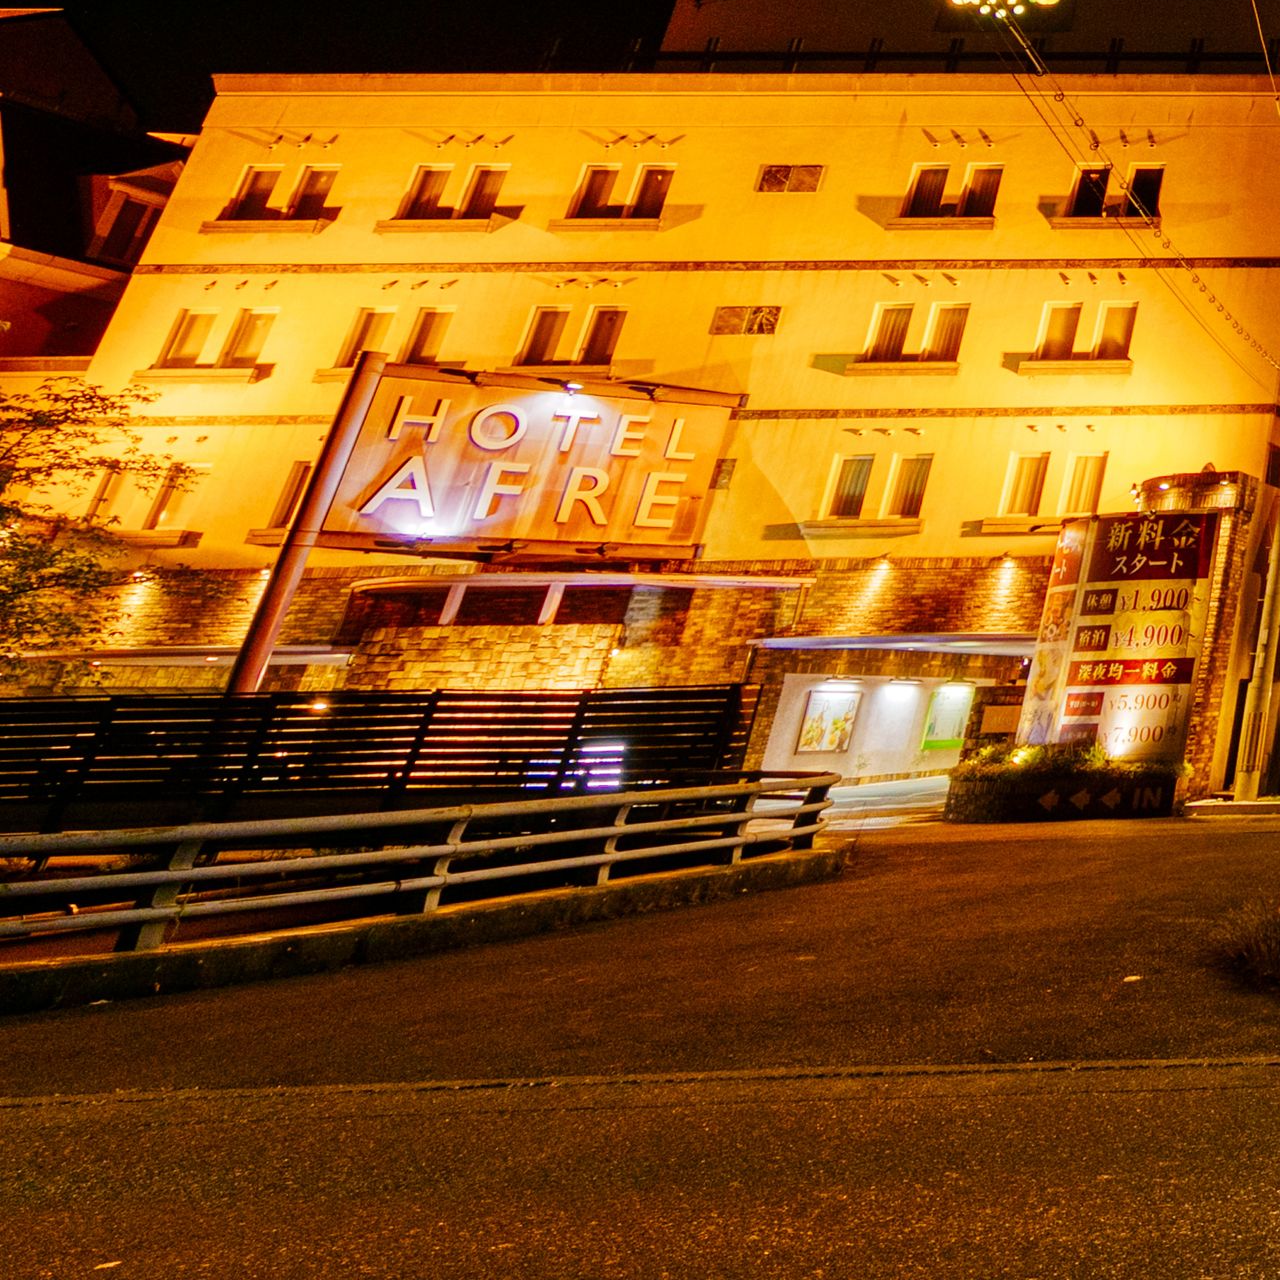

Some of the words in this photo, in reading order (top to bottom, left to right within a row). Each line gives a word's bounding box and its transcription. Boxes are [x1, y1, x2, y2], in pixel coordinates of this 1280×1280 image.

[387, 395, 697, 462] HOTEL
[357, 455, 688, 529] AFRE
[1106, 519, 1201, 552] 新料金
[1110, 552, 1184, 575] スタート
[1078, 629, 1106, 649] 宿泊
[1077, 661, 1178, 682] 深夜均一料金
[1131, 786, 1163, 810] IN
